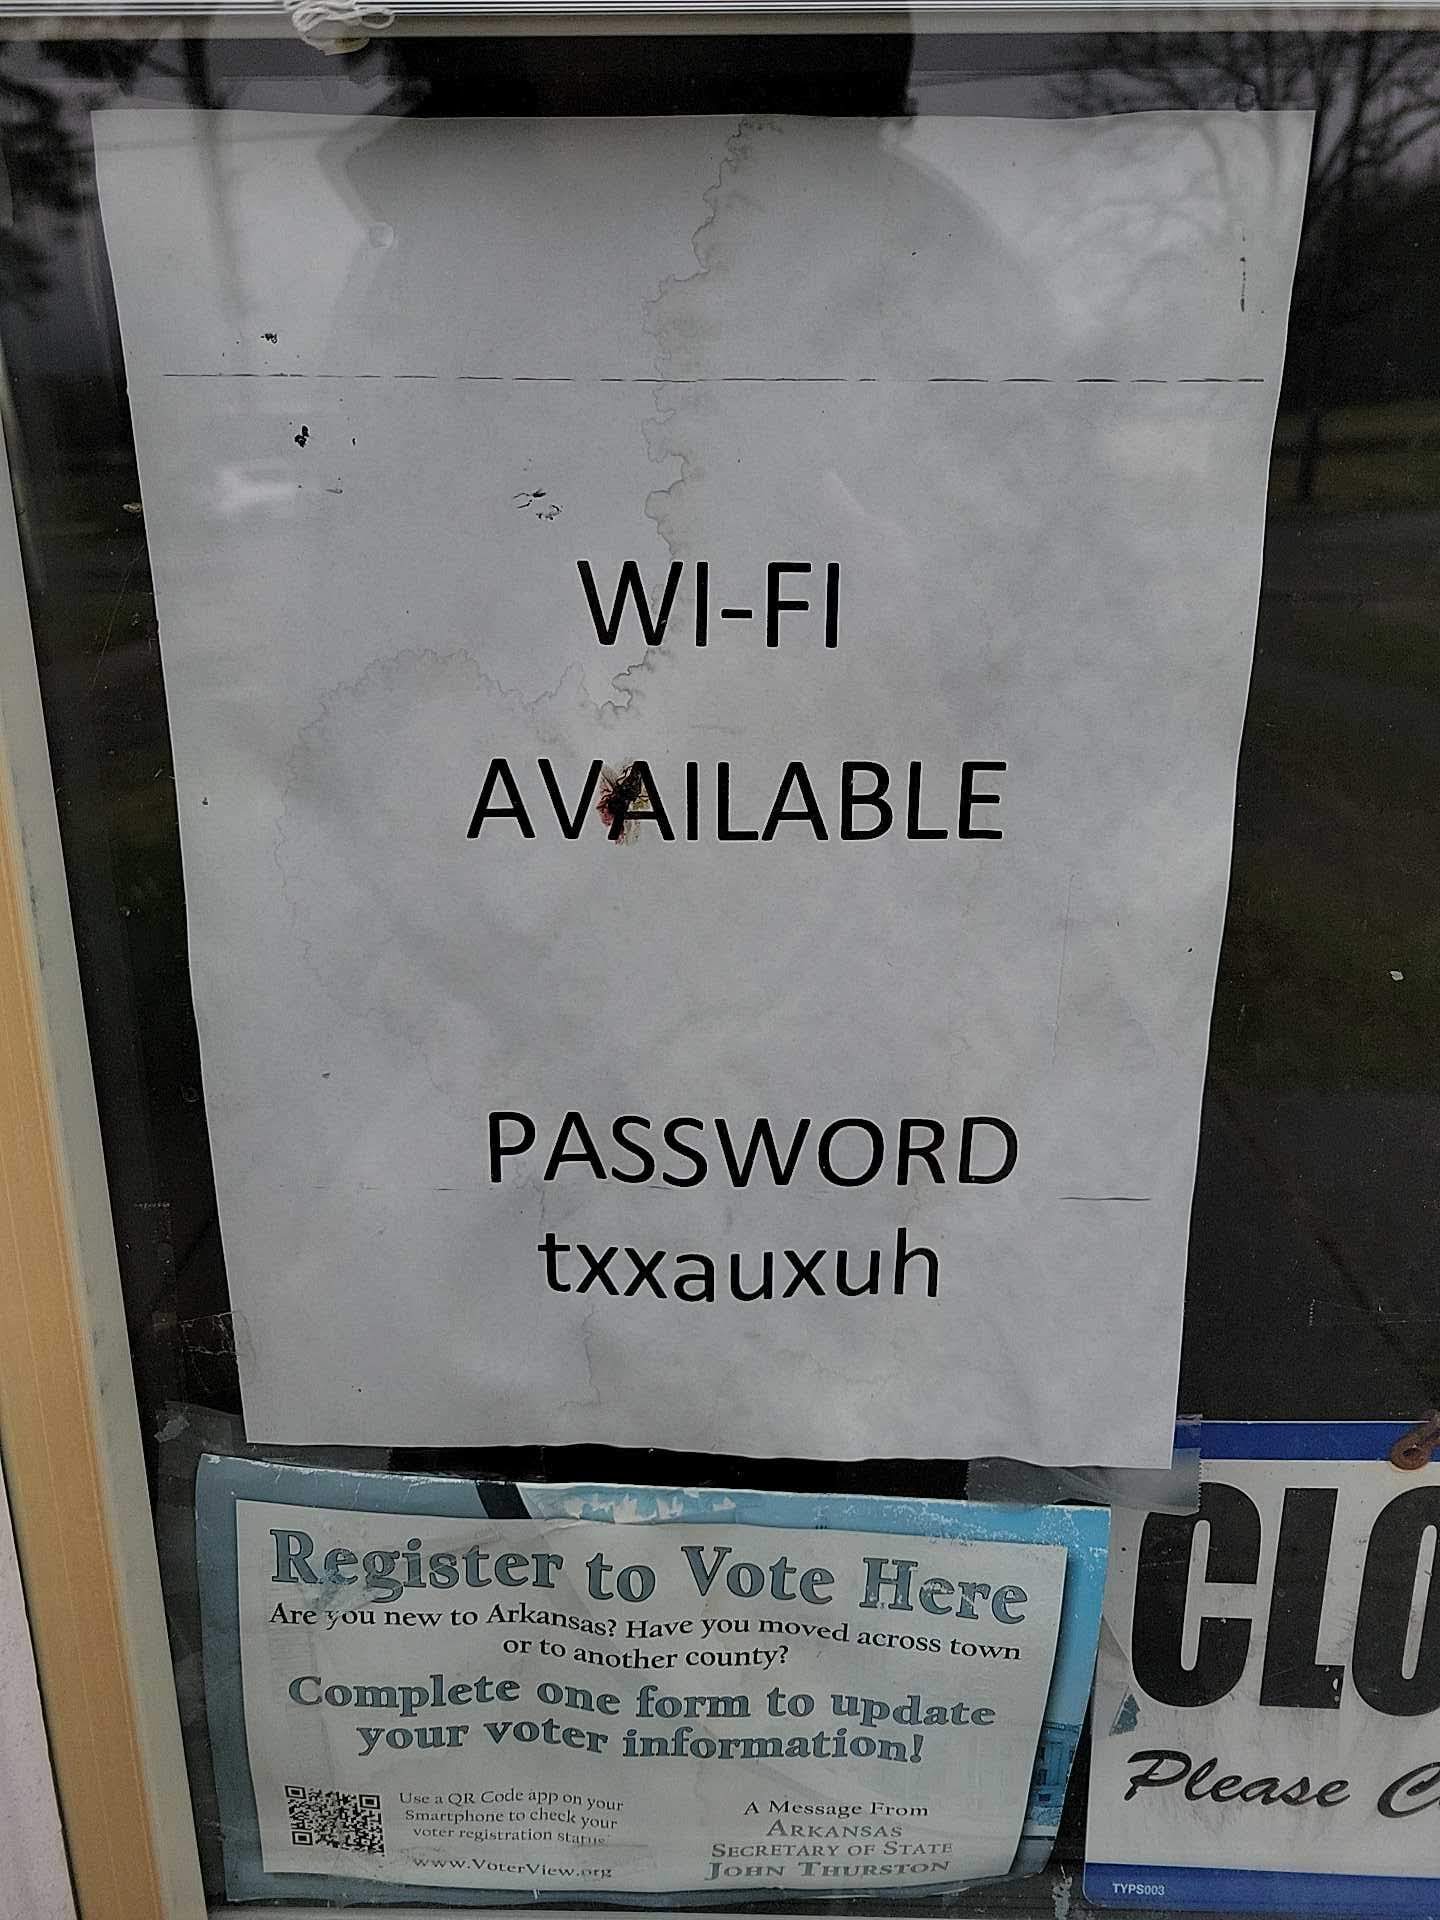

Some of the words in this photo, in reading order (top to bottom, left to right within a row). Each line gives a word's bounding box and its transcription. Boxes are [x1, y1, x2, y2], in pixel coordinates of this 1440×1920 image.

[577, 560, 839, 649] WI-FI
[466, 757, 1007, 843] AVAILABLE
[488, 1111, 1018, 1188] PASSWORD
[537, 1227, 940, 1302] txxauxuh
[270, 1528, 563, 1603] Register
[586, 1551, 657, 1602] to
[681, 1545, 835, 1605] Vote
[858, 1557, 1029, 1625] Here
[269, 1603, 318, 1626] Are
[325, 1608, 376, 1631] you
[384, 1608, 442, 1628] new
[450, 1608, 479, 1626] to
[486, 1602, 617, 1638] Arkansas?
[626, 1617, 693, 1640] Have
[701, 1617, 750, 1644] you
[759, 1617, 850, 1643] moved
[857, 1627, 942, 1653] across
[949, 1638, 1022, 1661] town
[503, 1637, 533, 1655] or
[539, 1639, 567, 1658] to
[573, 1647, 678, 1670] another
[685, 1645, 790, 1669] county?
[288, 1674, 521, 1718] Complete
[536, 1681, 620, 1716] one
[635, 1684, 751, 1720] form
[766, 1687, 816, 1718] to
[830, 1694, 996, 1727] update
[357, 1721, 470, 1756] your
[483, 1717, 608, 1754] voter
[622, 1726, 925, 1764] information!
[399, 1792, 430, 1806] Use
[434, 1795, 443, 1804] a
[448, 1792, 475, 1806] QR
[480, 1788, 524, 1804] Code
[527, 1791, 558, 1805] app
[562, 1794, 582, 1806] on
[586, 1797, 624, 1812] your
[1123, 1749, 1351, 1808] Please
[1377, 1761, 1440, 1819] C
[405, 1809, 504, 1824] Smartphone
[508, 1811, 525, 1822] to
[530, 1807, 576, 1824] check
[580, 1817, 618, 1831] your
[744, 1802, 760, 1816] A
[769, 1801, 862, 1818] Message
[871, 1802, 928, 1817] From
[766, 1819, 903, 1838] ARKANSAS
[412, 1827, 455, 1838] voter
[459, 1829, 552, 1843] registration
[711, 1842, 840, 1858] SECRETARY
[847, 1844, 875, 1856] OF
[883, 1840, 953, 1856] STATE
[704, 1862, 785, 1881] JOHN
[798, 1860, 951, 1877] THURSTON
[1112, 1883, 1165, 1896] TYPS003
